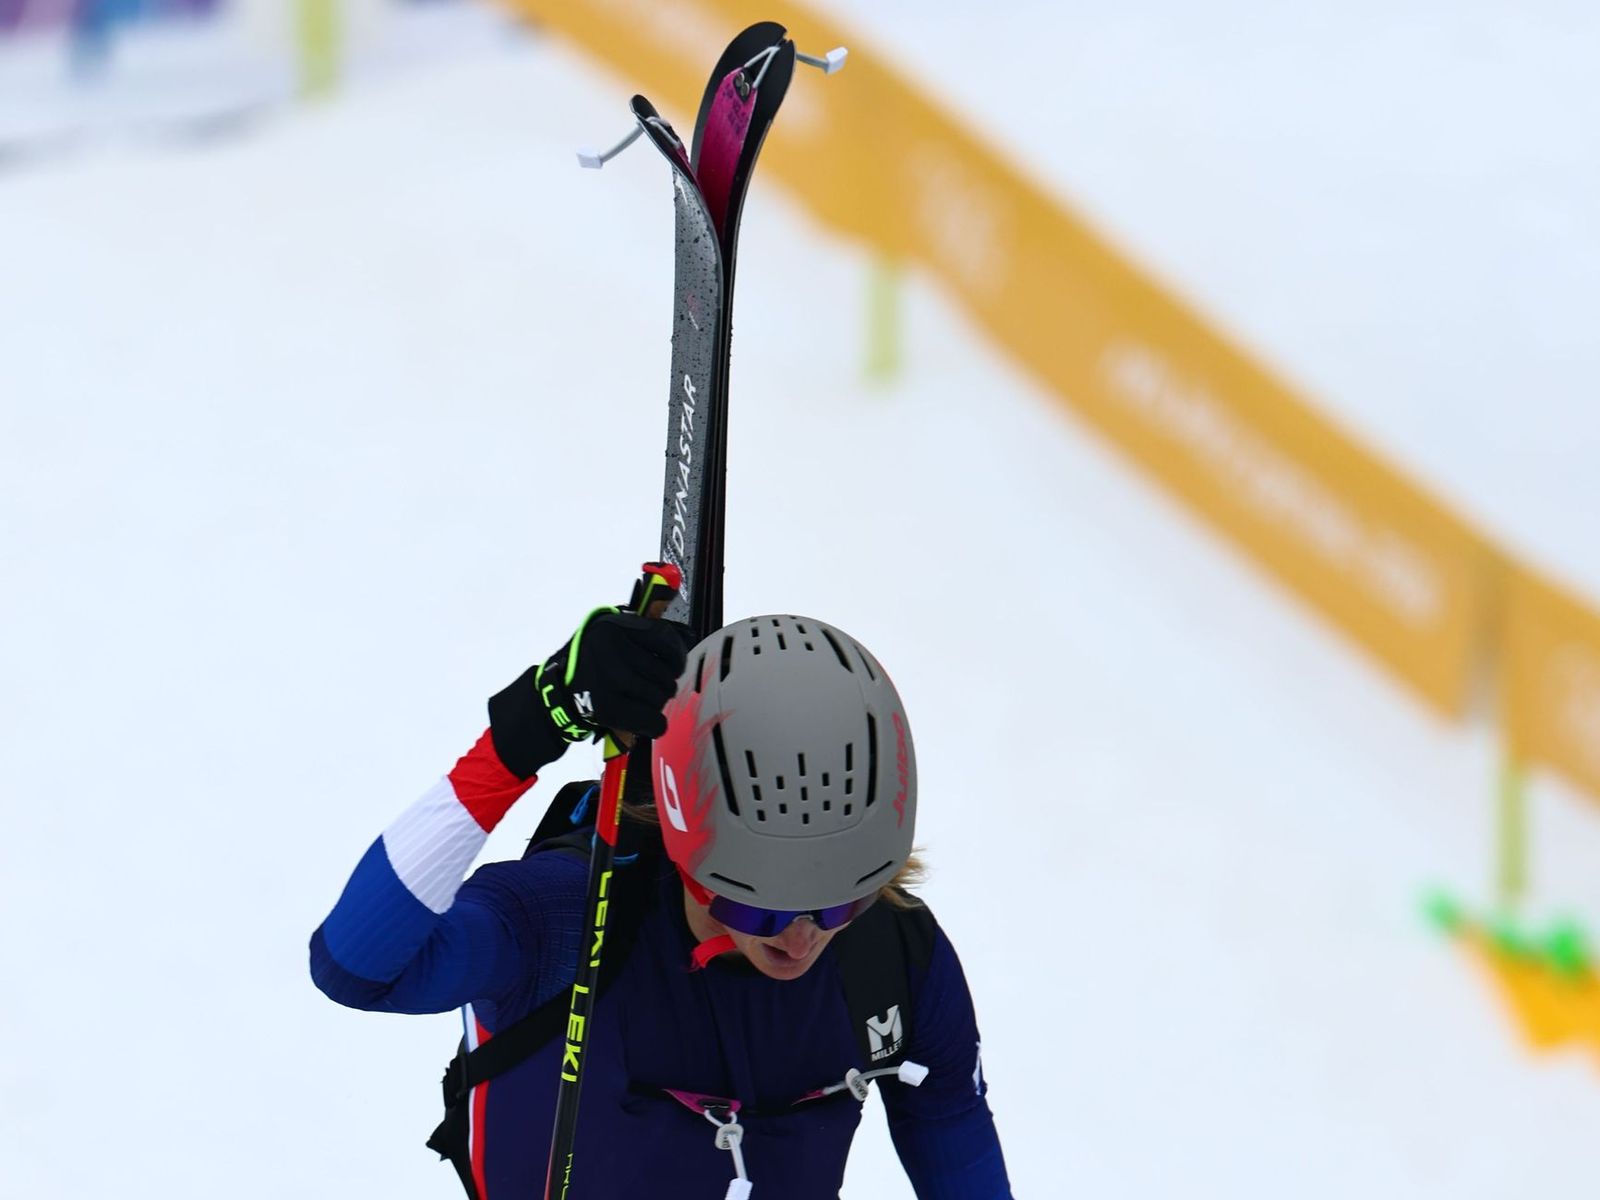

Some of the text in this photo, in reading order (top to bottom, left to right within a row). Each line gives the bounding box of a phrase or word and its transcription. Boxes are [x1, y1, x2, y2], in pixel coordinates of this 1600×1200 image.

[671, 373, 697, 558] DYNASTAR
[589, 870, 613, 968] LEKI
[561, 983, 590, 1083] LEKI
